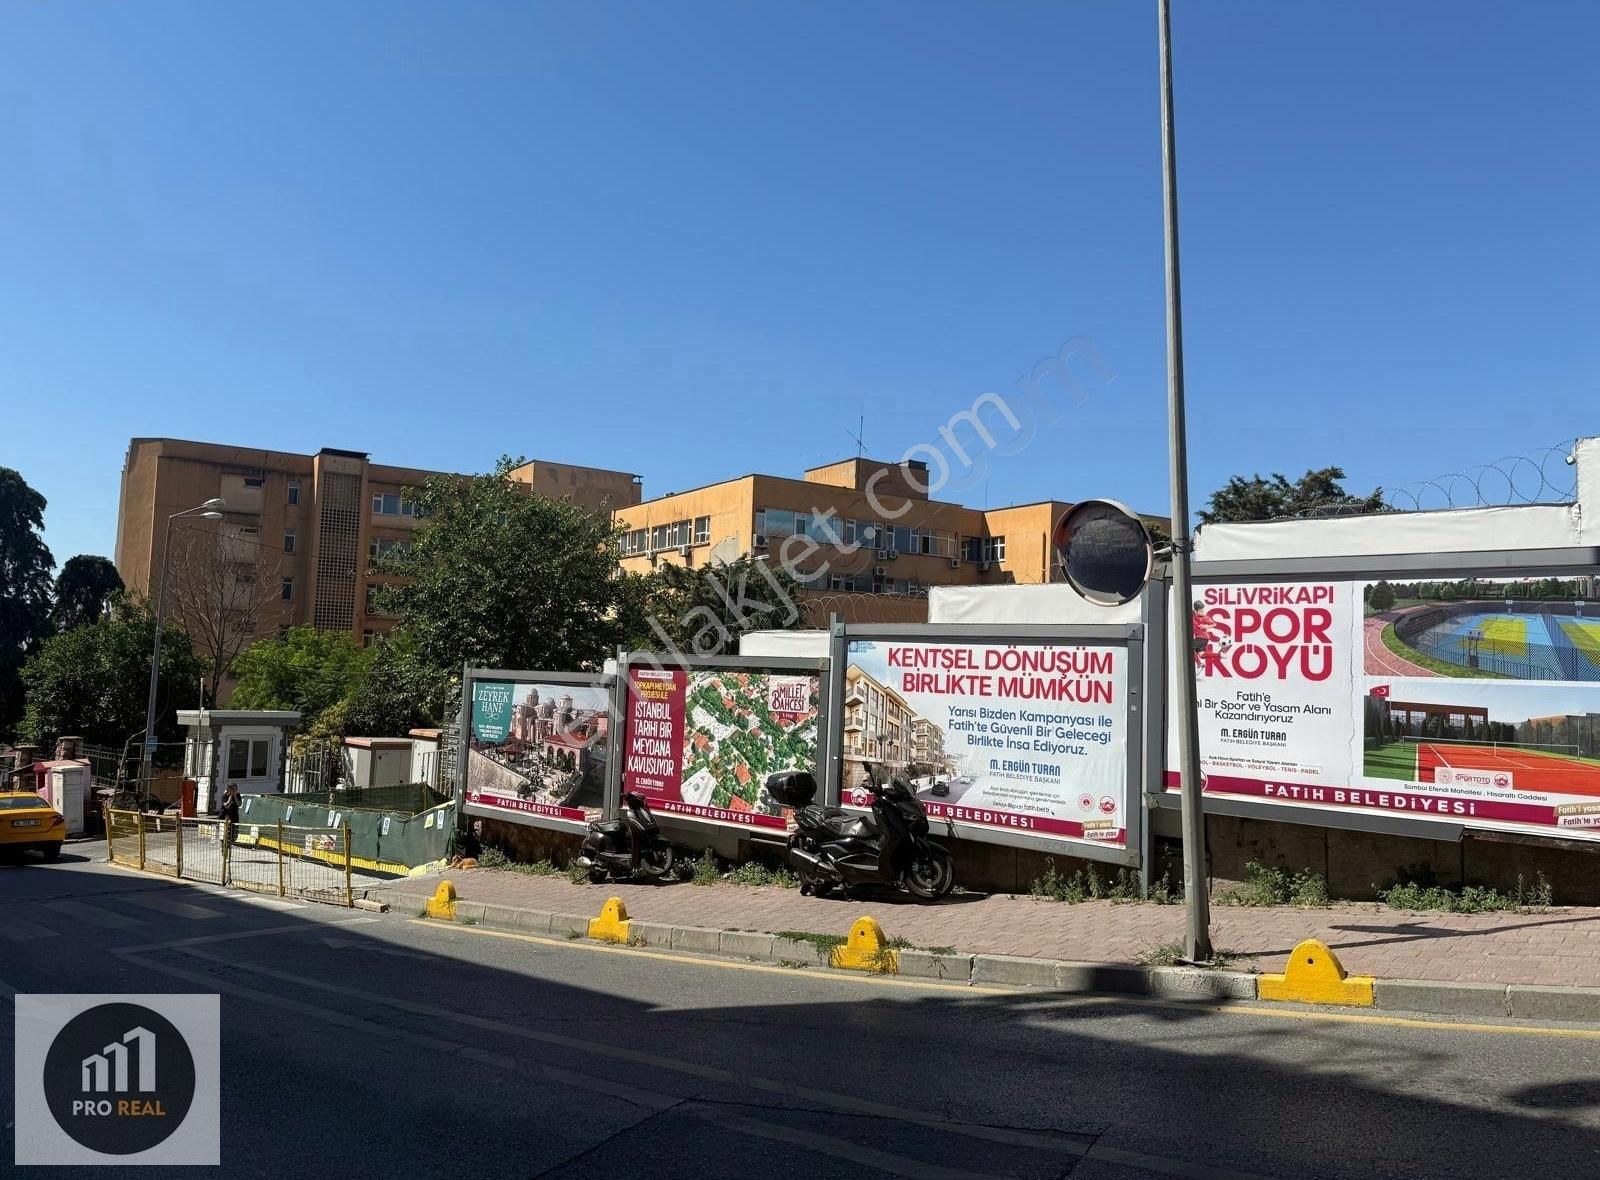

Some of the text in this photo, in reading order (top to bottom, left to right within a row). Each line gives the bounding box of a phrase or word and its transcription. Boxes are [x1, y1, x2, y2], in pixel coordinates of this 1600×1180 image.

[1206, 608, 1332, 644] SPOR
[888, 647, 980, 670] KENTSEL
[985, 644, 1113, 679] DÖNÜŞÜM
[1204, 643, 1333, 681] KÖYÜ
[903, 667, 1113, 704] BİRLİKTE MÜMKÜN
[478, 689, 510, 703] ZEYREK
[1236, 691, 1271, 703] Fatih'e
[481, 701, 504, 714] HANE
[948, 705, 1113, 727] Yarısı Bizden Kampanyası ile
[1215, 710, 1294, 725] Kazandırıyoruz
[1221, 700, 1246, 712] Spor
[1248, 703, 1261, 711] ve
[1303, 704, 1332, 715] Alanı
[948, 719, 1111, 745] Fatih'te Güvenli Bir Geleceği
[1221, 727, 1287, 741] M. ERGÜN TURAN
[632, 737, 671, 758] MEYDANA
[968, 734, 1004, 748] Birlikte
[1034, 740, 1088, 756] Ediyoruz.
[989, 758, 1061, 777] M. ERGÜN TURAN
[1517, 793, 1548, 802] Caddesi
